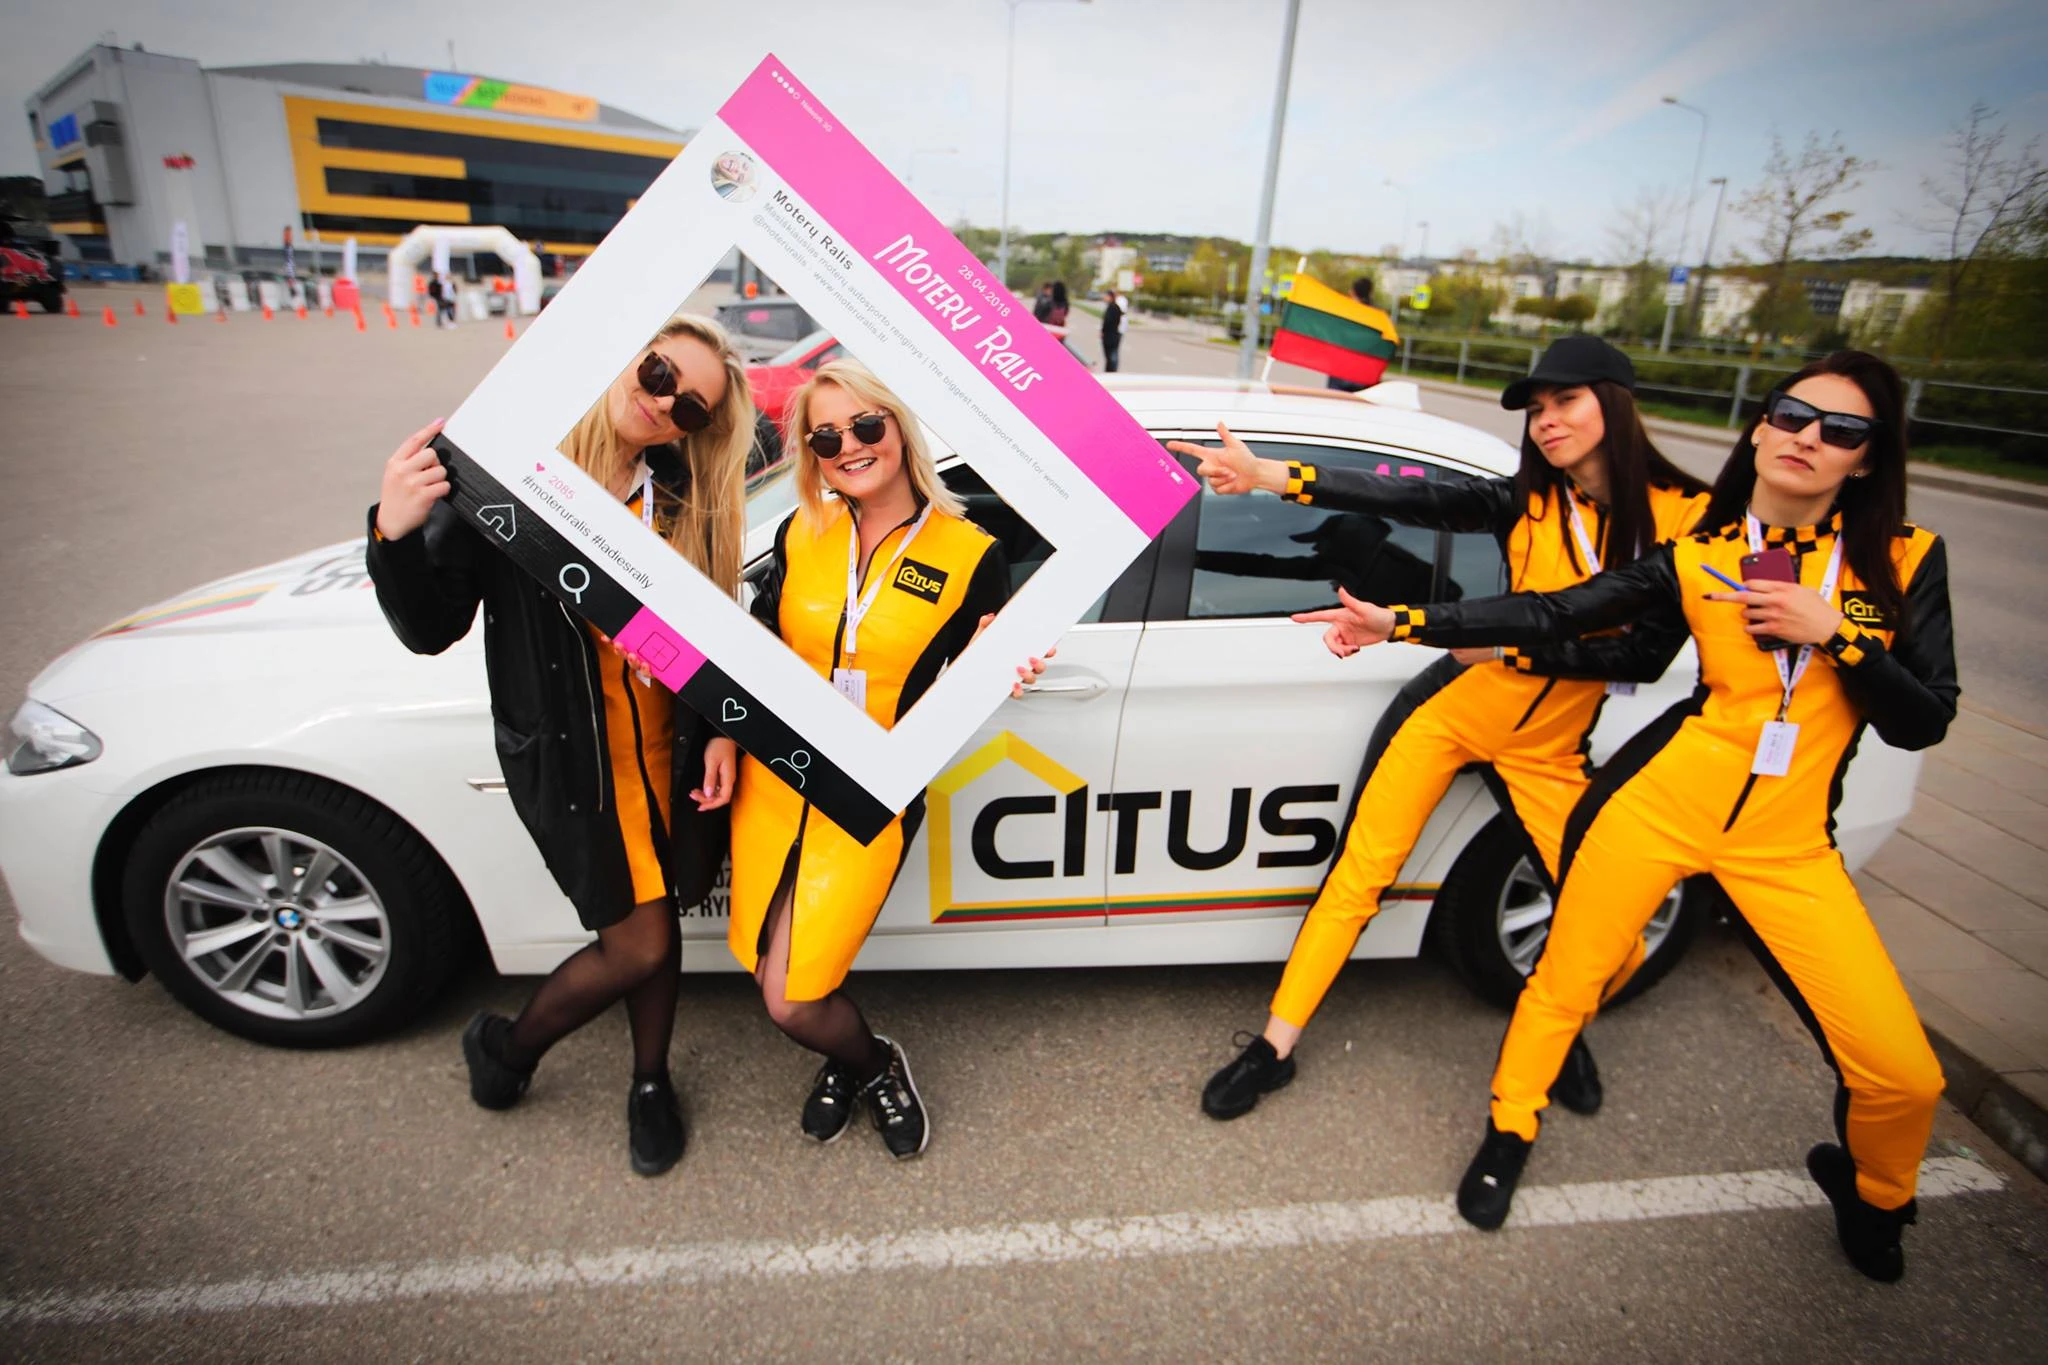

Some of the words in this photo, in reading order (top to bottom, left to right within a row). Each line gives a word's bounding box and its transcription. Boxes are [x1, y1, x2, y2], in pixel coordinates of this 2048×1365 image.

[752, 214, 807, 267] @moteruralis
[819, 235, 853, 270] Ralis
[957, 264, 1011, 317] 28.04.2018
[847, 286, 890, 327] autosporto
[889, 325, 924, 359] renginys
[928, 360, 944, 378] The
[942, 375, 973, 406] biggest
[970, 403, 1014, 445] motorsport
[1010, 443, 1033, 465] event
[1031, 461, 1044, 474] for
[1043, 474, 1070, 501] women
[548, 475, 576, 500] 2085
[522, 475, 591, 537] #moteruralis
[591, 534, 653, 590] #ladiesrally
[900, 568, 942, 593] CITUS
[971, 783, 1340, 880] CITUS
